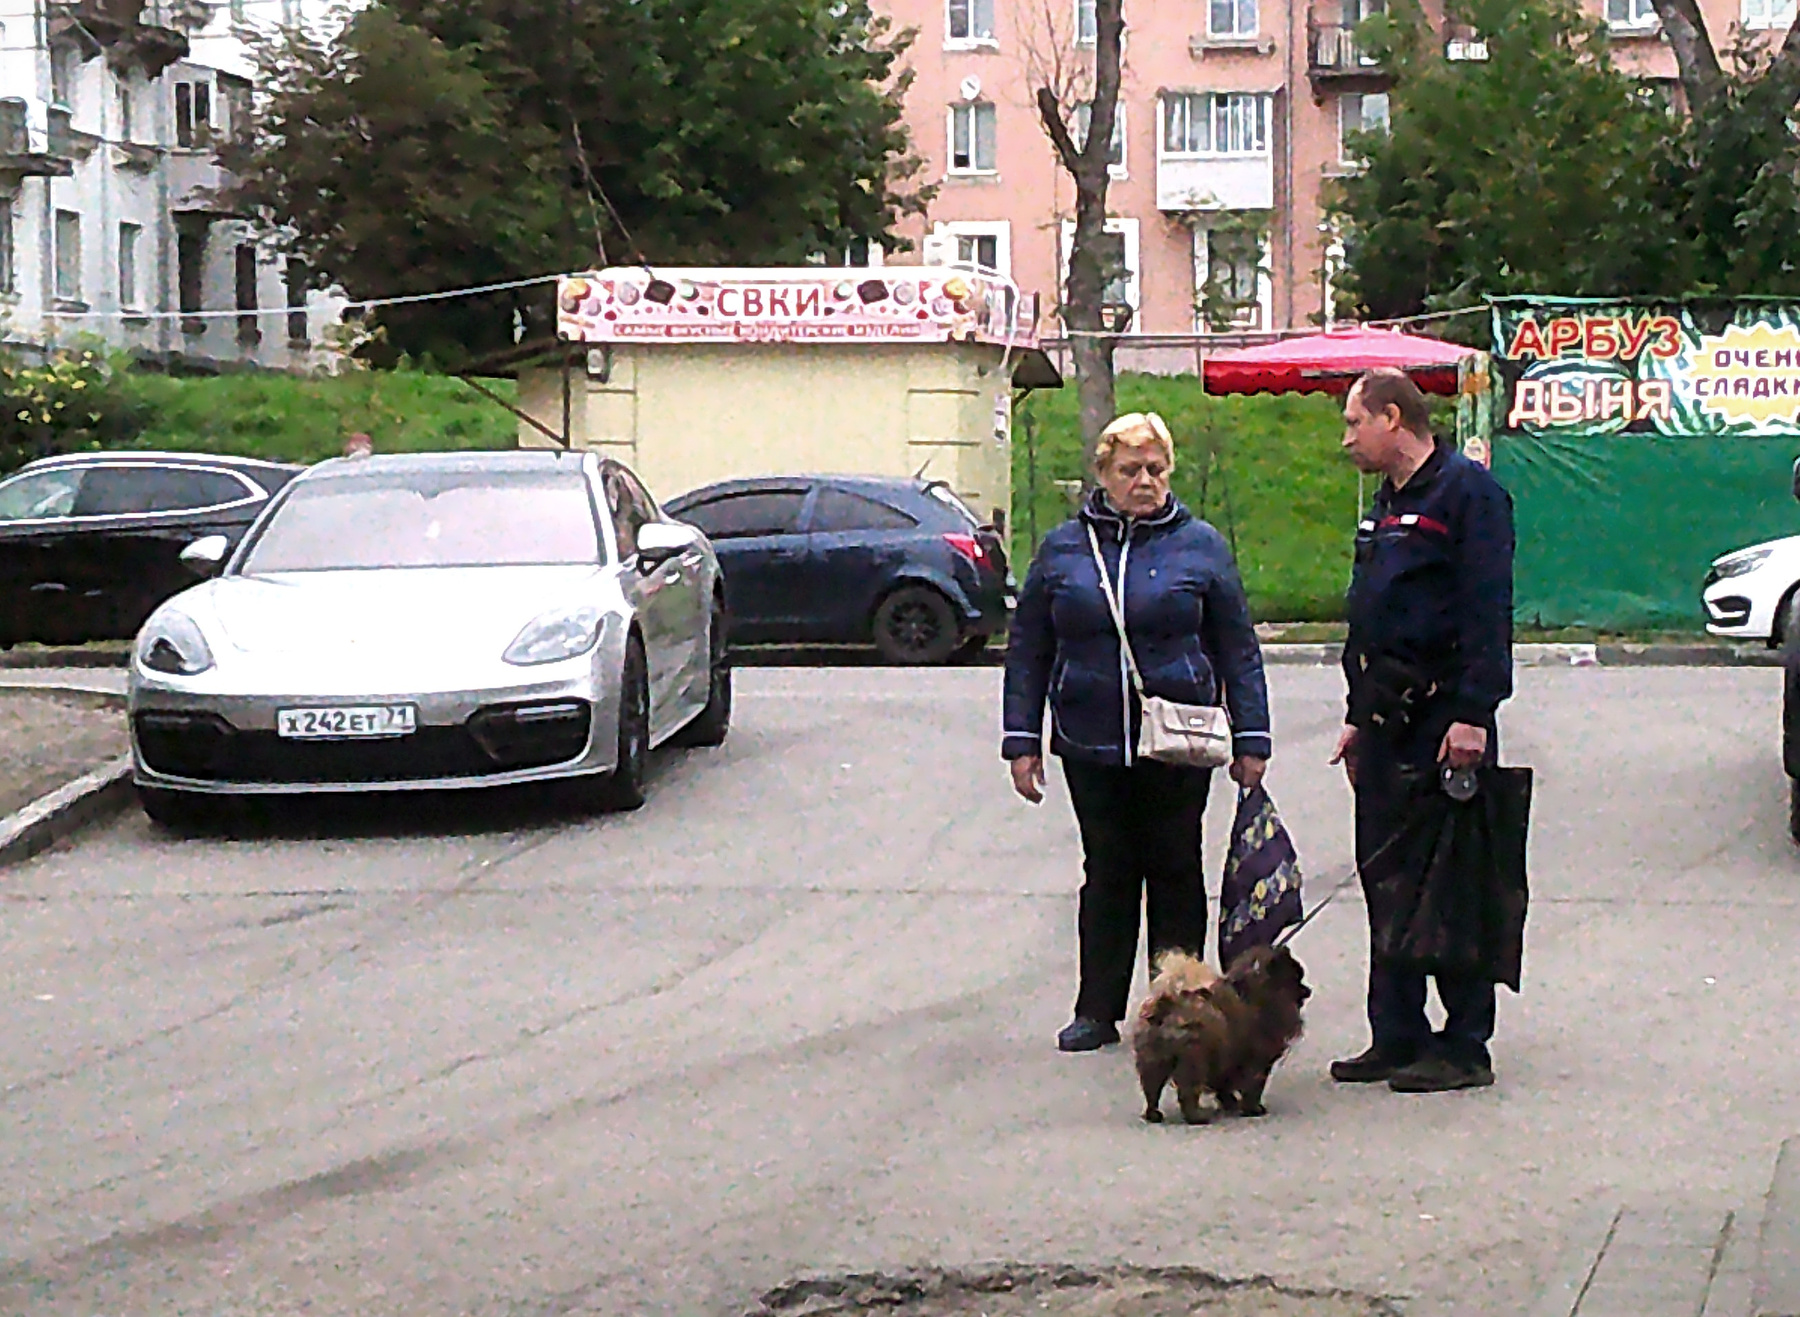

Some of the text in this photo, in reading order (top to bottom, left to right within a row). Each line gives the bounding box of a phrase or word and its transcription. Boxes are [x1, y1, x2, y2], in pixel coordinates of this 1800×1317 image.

[717, 288, 819, 316] СВКИ
[1508, 316, 1682, 359] АРБУЗ
[1508, 379, 1671, 428] ДЫНЯ
